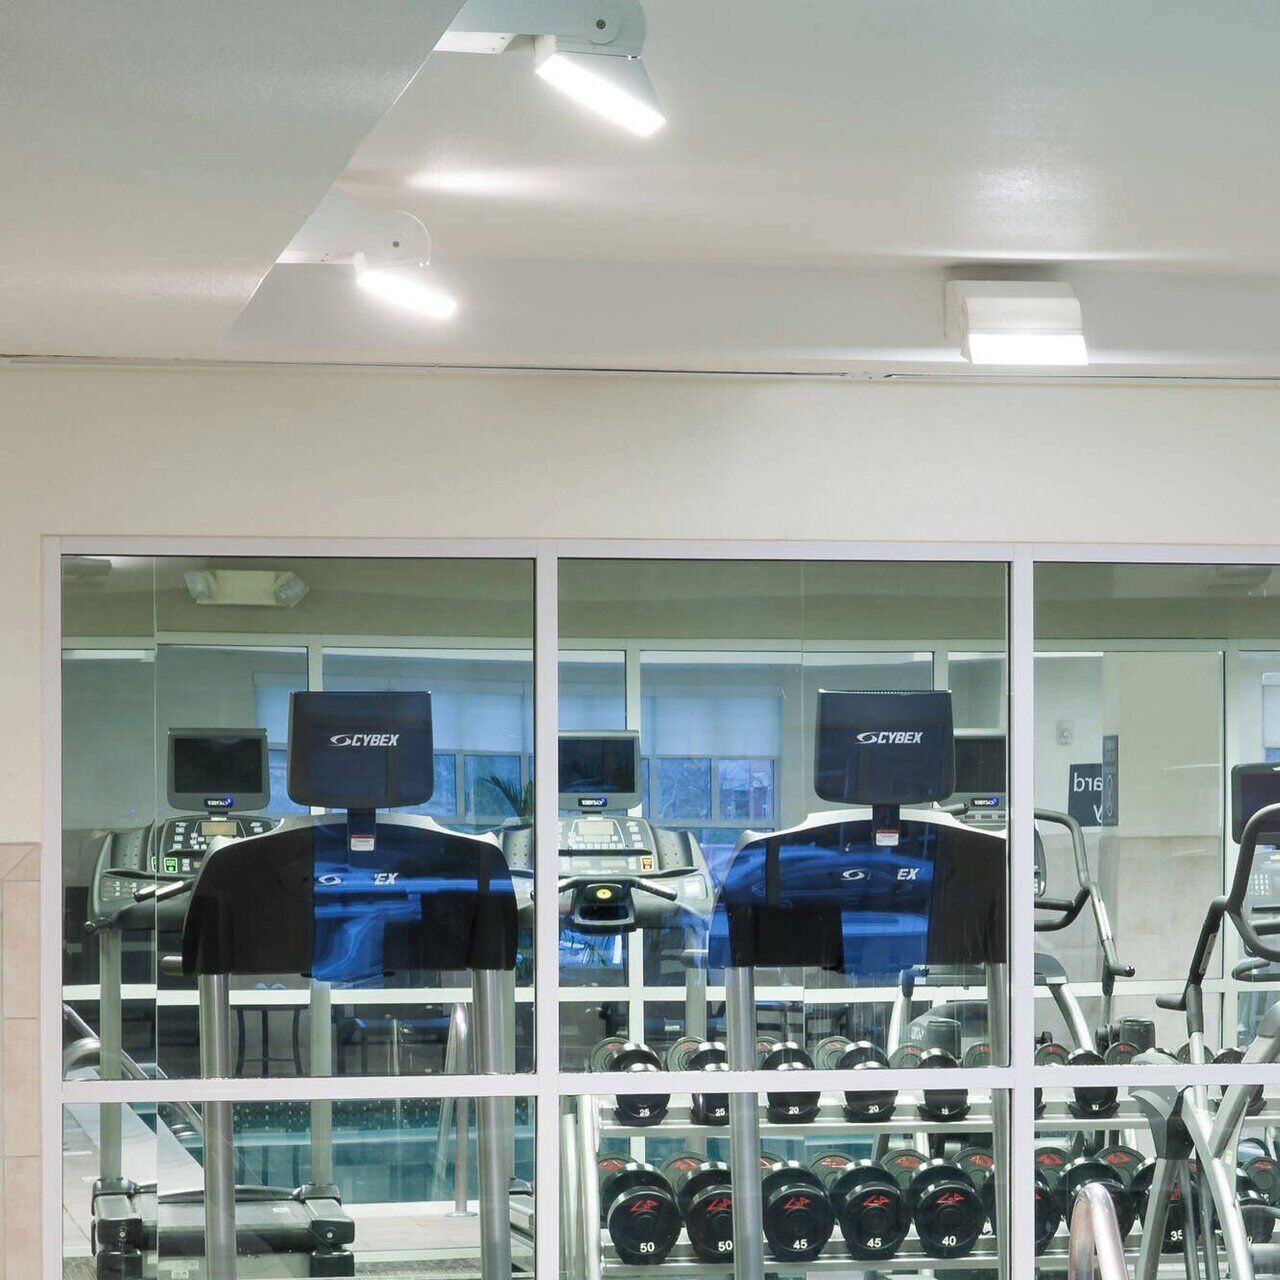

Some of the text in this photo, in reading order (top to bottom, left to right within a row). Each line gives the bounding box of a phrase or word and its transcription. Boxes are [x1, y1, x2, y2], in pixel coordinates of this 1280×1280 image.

[351, 734, 400, 746] CYBEX
[877, 732, 923, 744] CYBEX
[639, 1108, 650, 1117] 25
[715, 1108, 725, 1117] 25
[788, 1106, 799, 1114] 20
[868, 1105, 879, 1114] 20
[718, 1240, 733, 1252] 50
[793, 1238, 808, 1250] 45
[867, 1238, 882, 1248] 45
[942, 1235, 957, 1246] 40
[640, 1242, 655, 1253] 50
